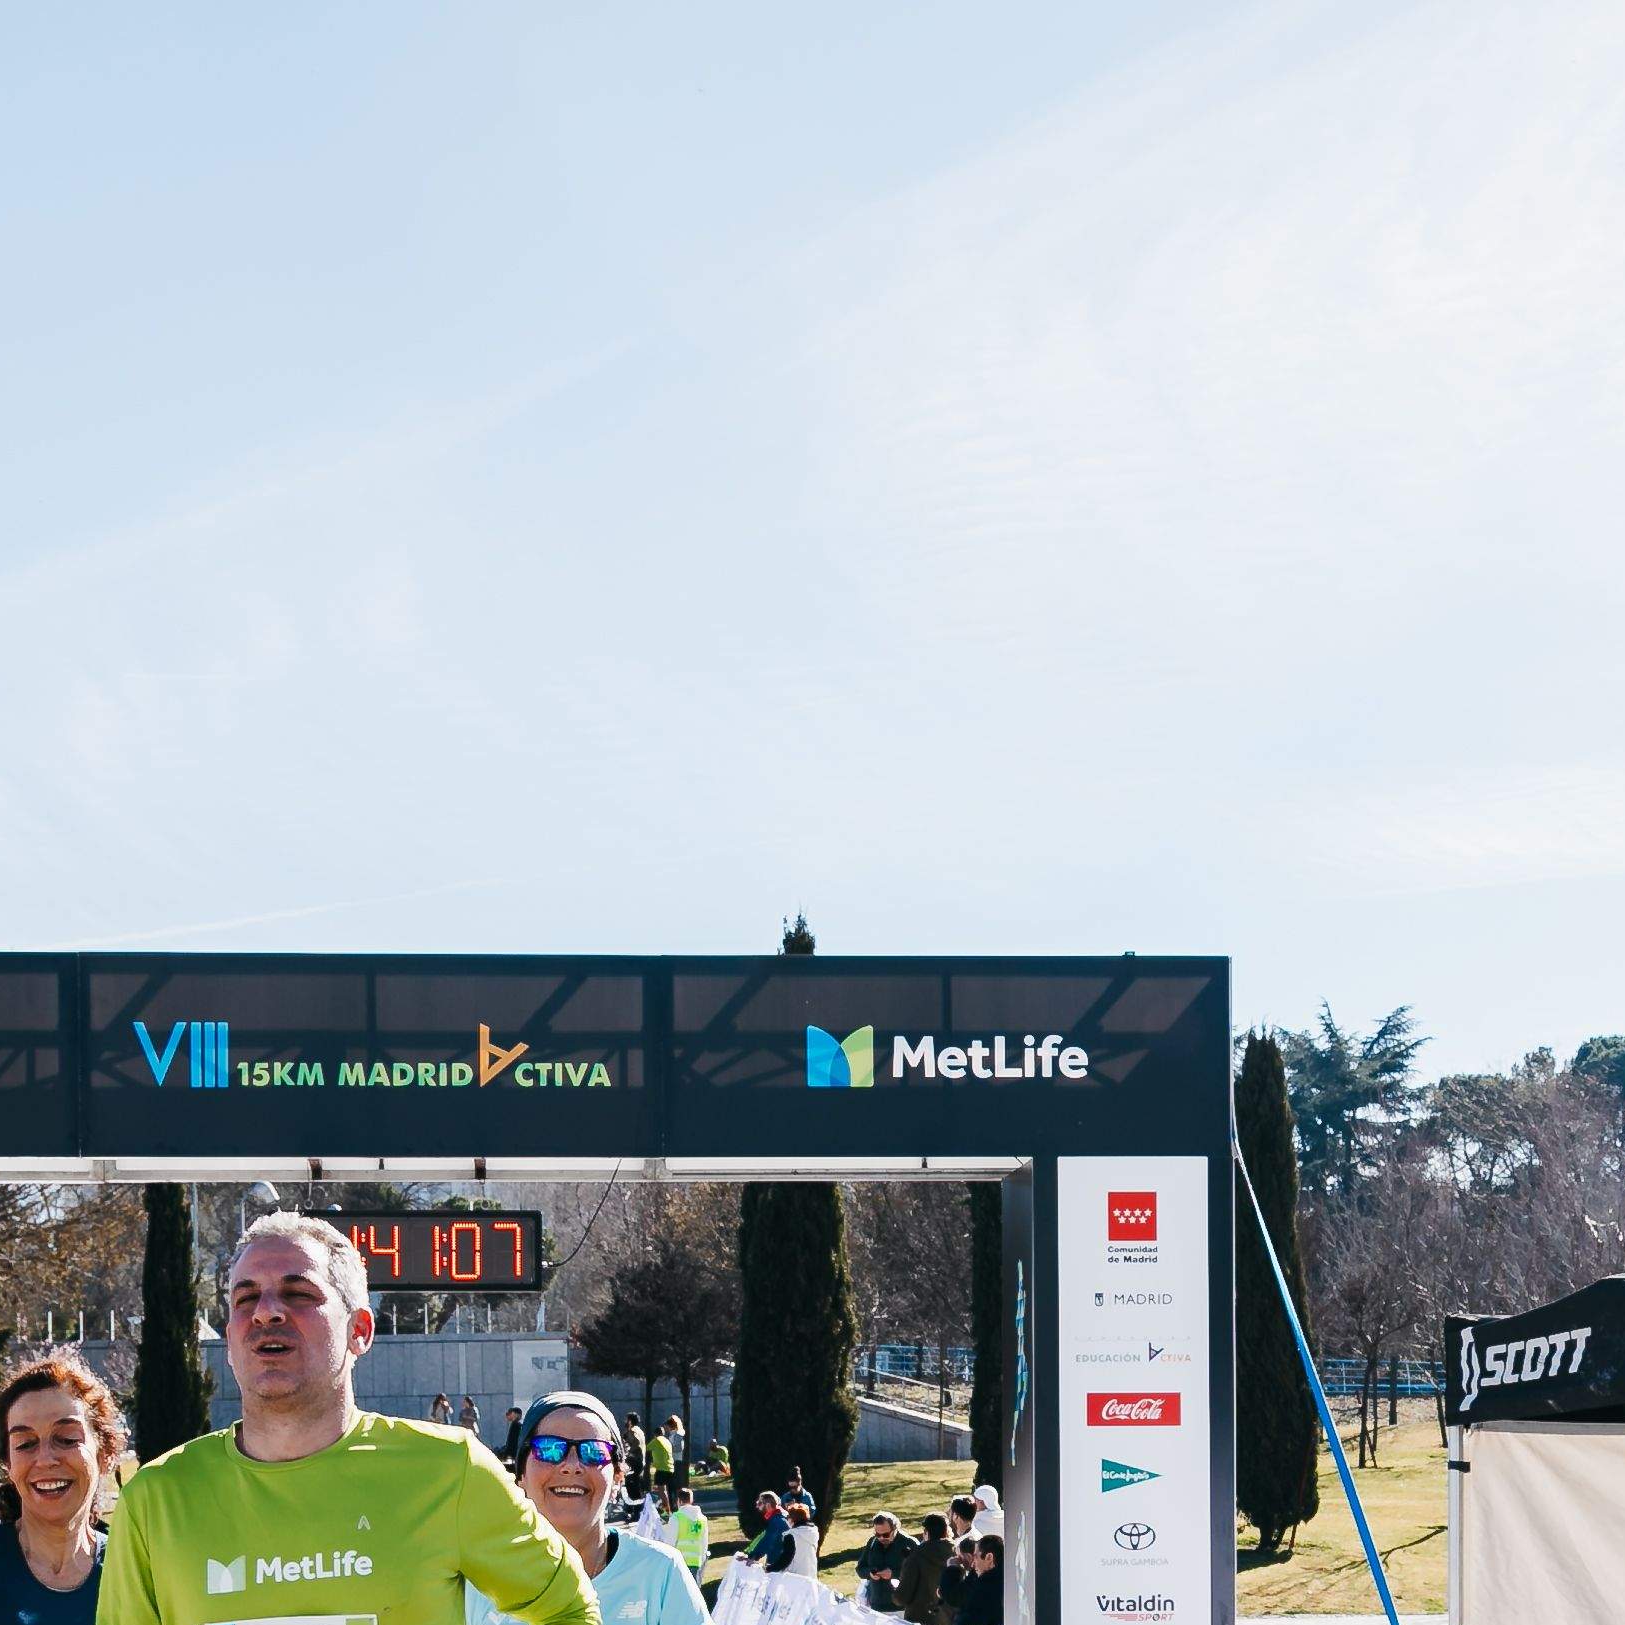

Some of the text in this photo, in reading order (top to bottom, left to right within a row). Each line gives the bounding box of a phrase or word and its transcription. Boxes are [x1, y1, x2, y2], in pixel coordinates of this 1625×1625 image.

[132, 1021, 229, 1088] VIII
[237, 1062, 325, 1087] 15KM
[892, 1034, 1089, 1078] MetLife
[1113, 1293, 1173, 1305] MADRID
[1480, 1327, 1592, 1387] SCOTT
[256, 1550, 373, 1584] MetLife
[1096, 1594, 1175, 1612] Vitaldin
[1137, 1613, 1175, 1622] SPORT
